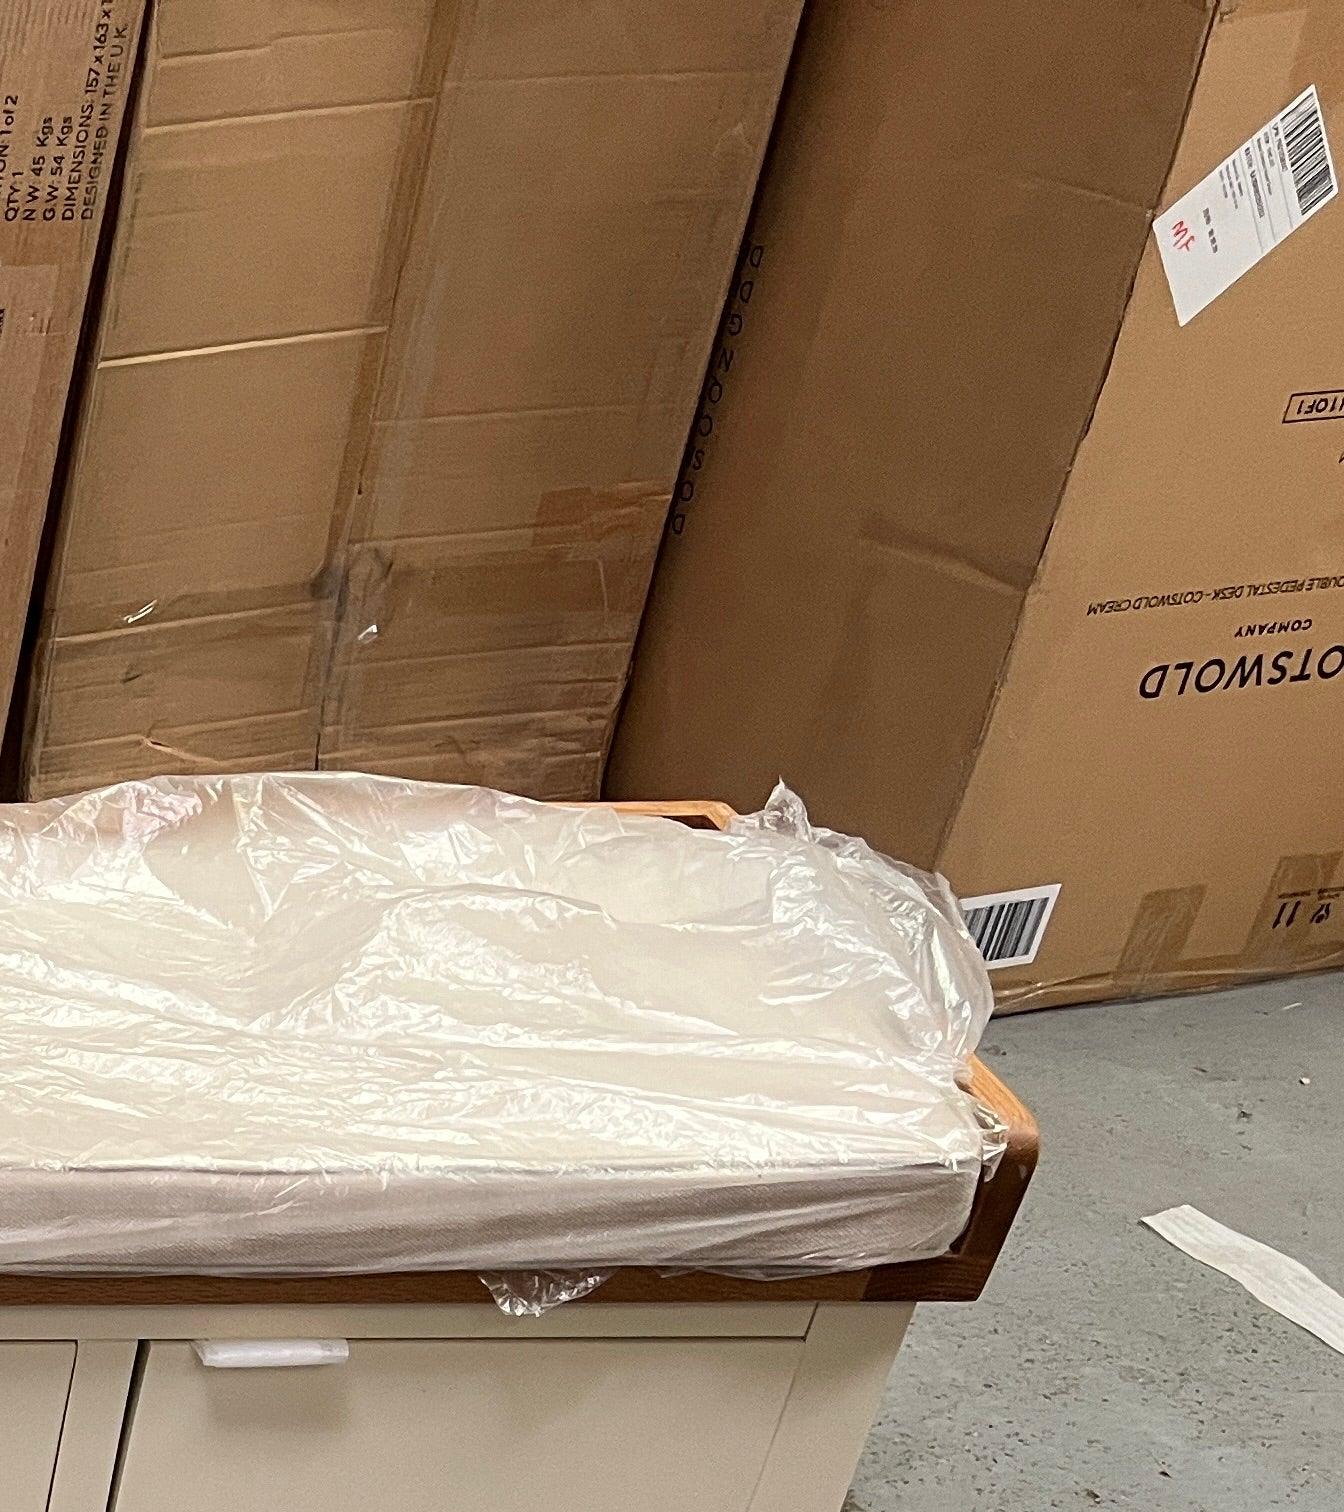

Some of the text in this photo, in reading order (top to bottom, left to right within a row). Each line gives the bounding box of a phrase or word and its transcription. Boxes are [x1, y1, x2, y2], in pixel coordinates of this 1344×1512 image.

[85, 67, 100, 94] 157
[93, 23, 109, 50] 163
[103, 63, 121, 98] THE
[5, 95, 18, 105] 2
[99, 103, 113, 121] IN
[36, 117, 54, 147] Kgs
[56, 116, 73, 147] Kgs
[31, 156, 45, 176] 45
[51, 154, 65, 176] 54
[81, 126, 109, 220] DESIGNED
[1247, 579, 1306, 598] PEDESTAL
[1086, 599, 1131, 616] CREAM
[1234, 618, 1313, 638] COMPANY
